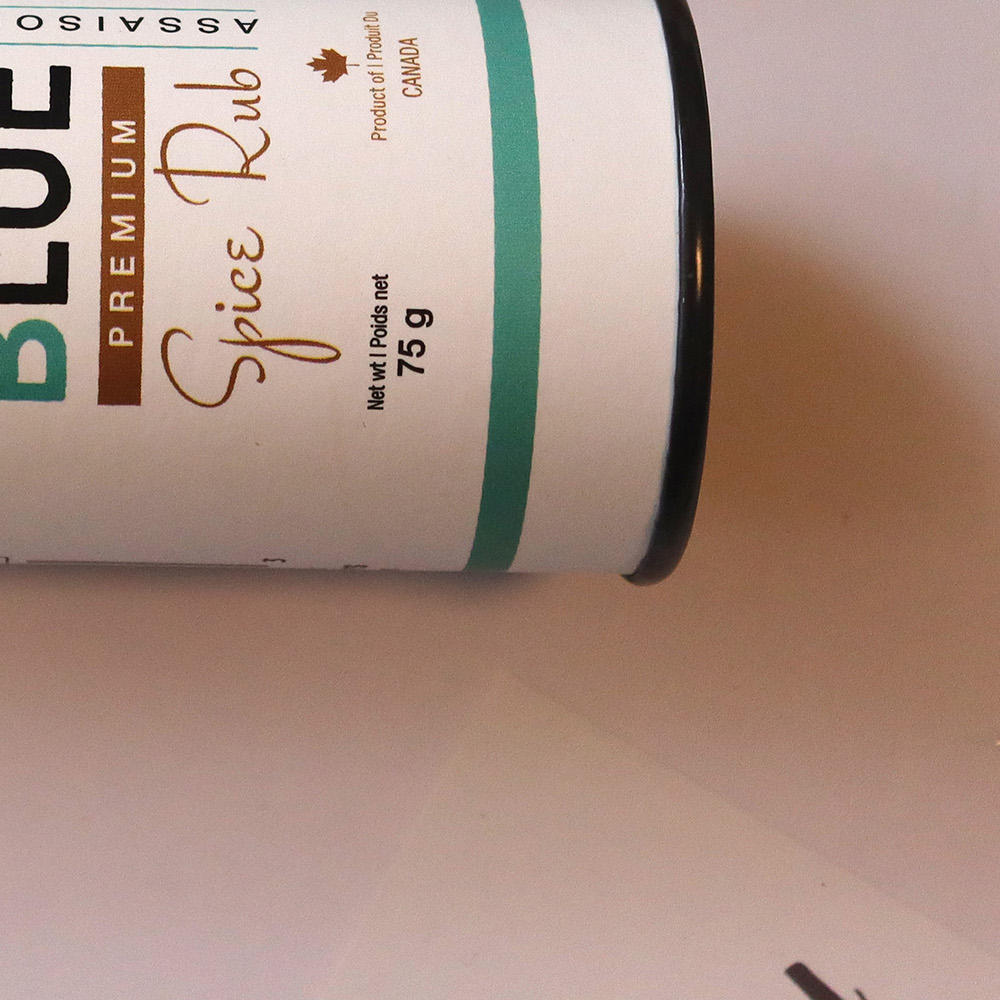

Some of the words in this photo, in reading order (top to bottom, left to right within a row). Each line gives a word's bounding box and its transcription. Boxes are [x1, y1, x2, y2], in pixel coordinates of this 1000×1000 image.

[362, 11, 379, 23] Du
[364, 25, 383, 61] Produit
[367, 71, 385, 84] of
[398, 37, 423, 98] CANADA
[370, 87, 388, 142] Product
[153, 67, 271, 206] Rub
[108, 119, 137, 348] PREMIUM
[371, 273, 389, 300] net
[160, 226, 342, 408] Spice
[369, 304, 389, 348] Poids
[404, 308, 434, 329] g
[369, 361, 387, 382] wt
[396, 338, 426, 377] 75
[367, 384, 386, 411] Net
